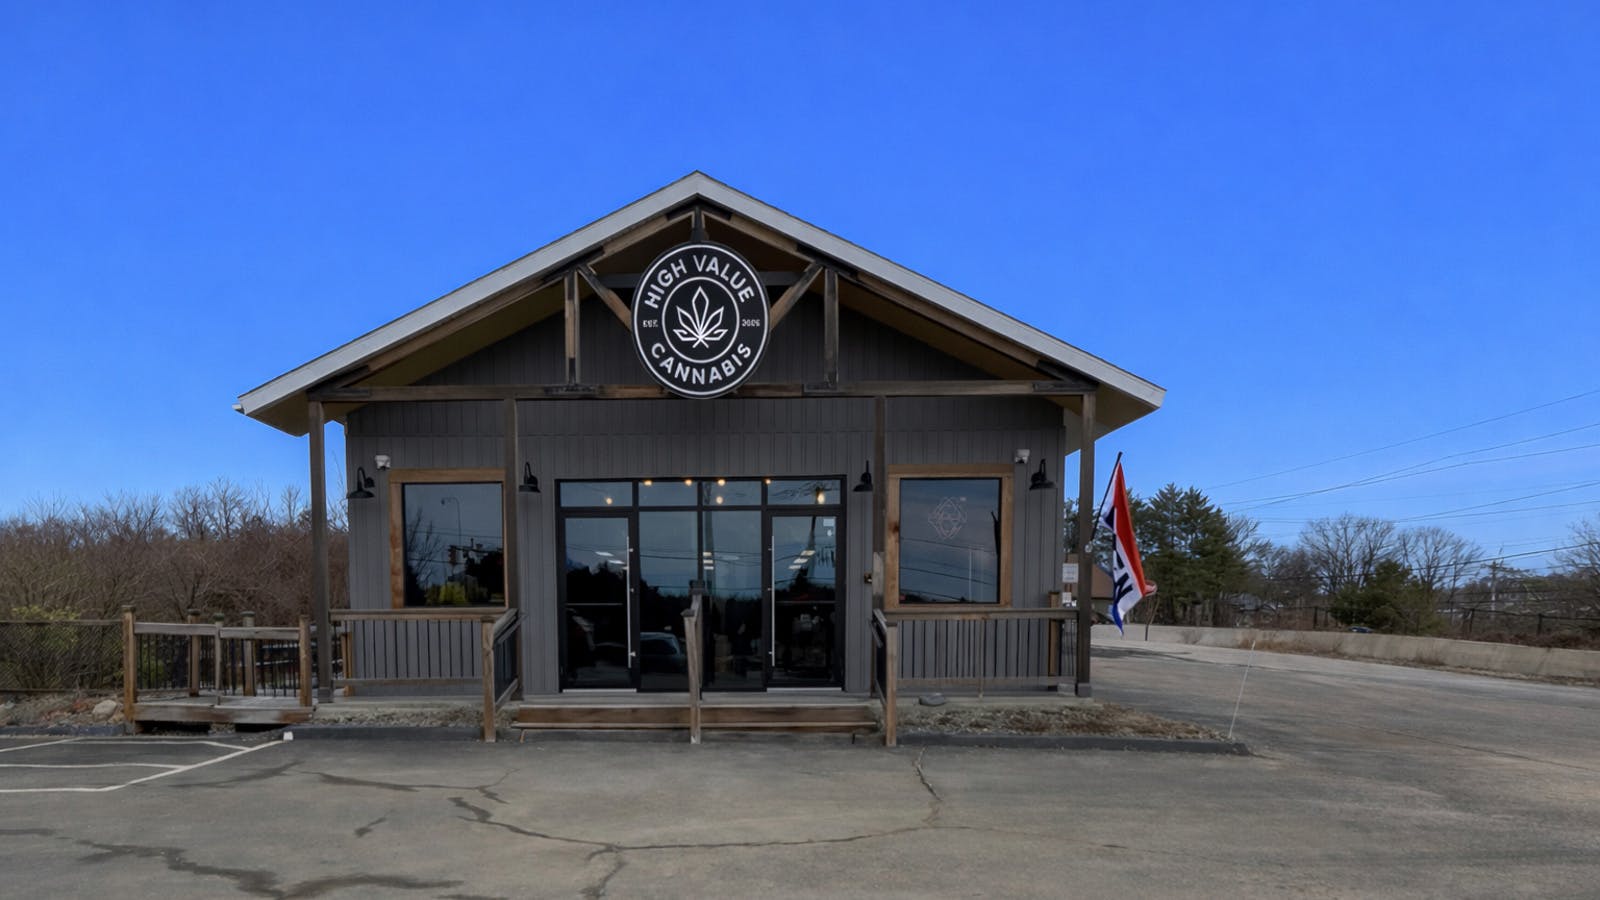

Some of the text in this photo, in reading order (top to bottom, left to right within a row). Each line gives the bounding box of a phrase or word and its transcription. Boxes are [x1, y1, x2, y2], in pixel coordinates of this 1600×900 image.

[644, 254, 755, 309] HIGH VALUE
[651, 342, 751, 385] CANNABIS
